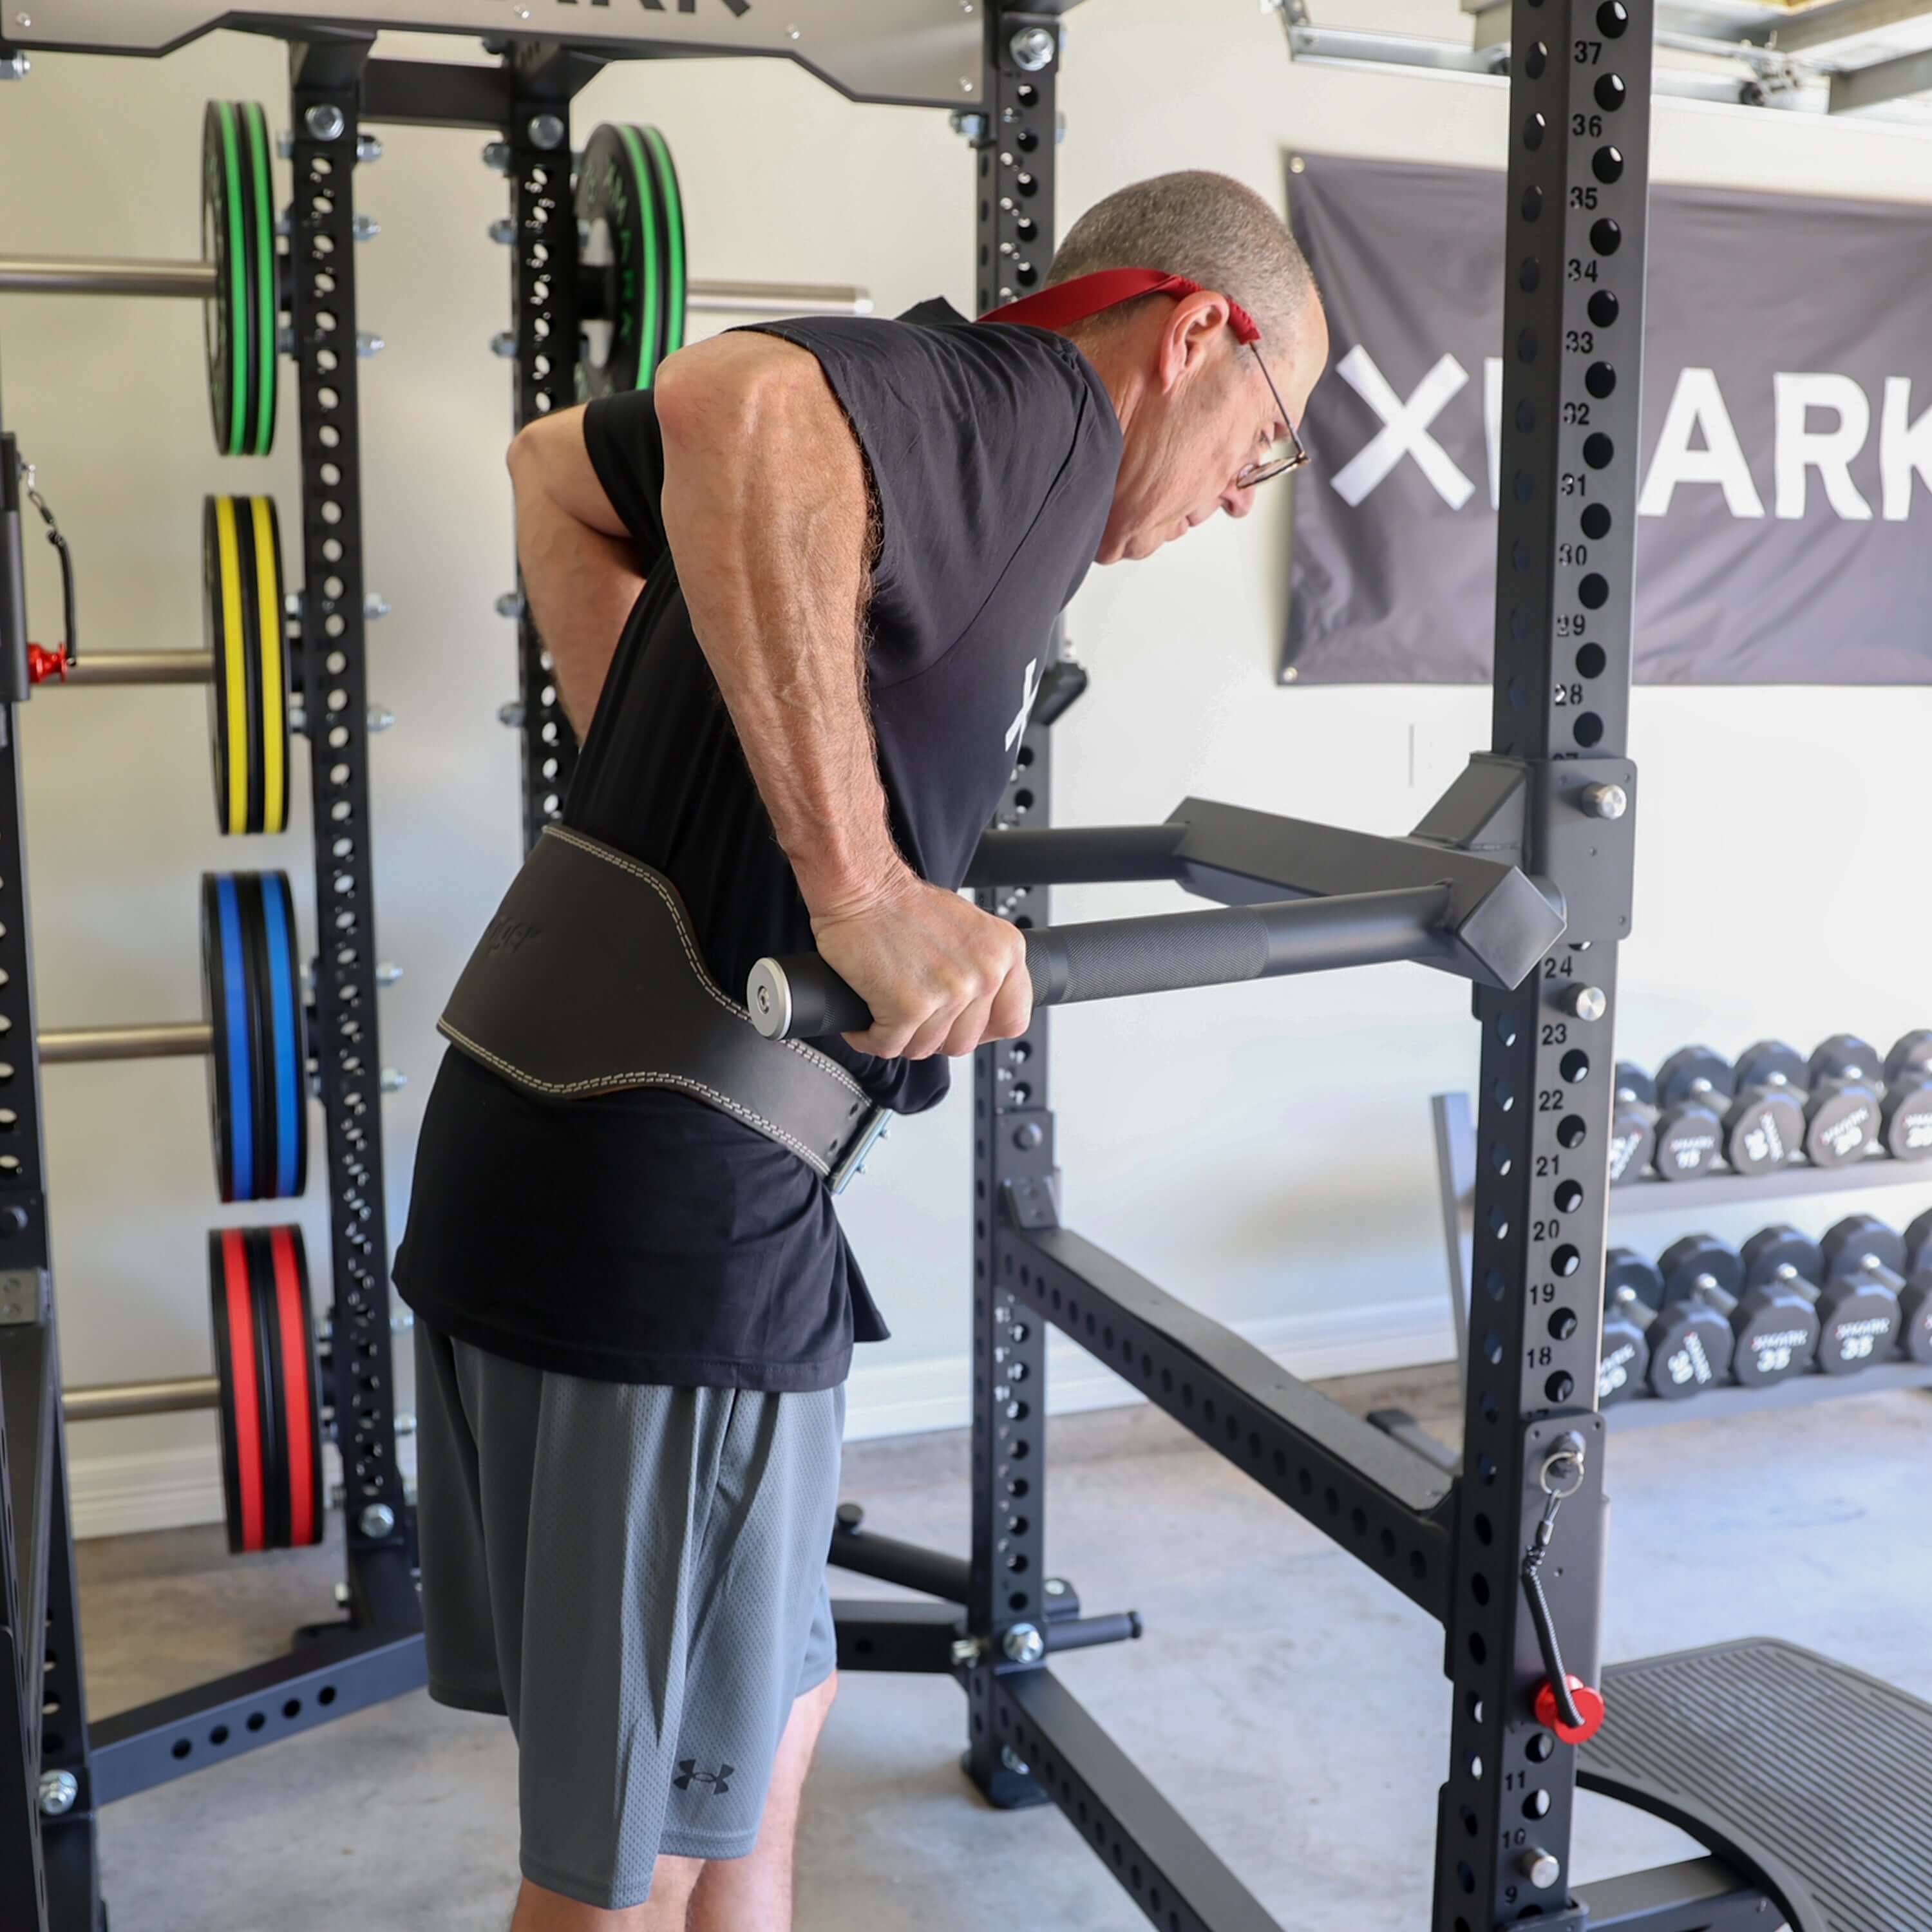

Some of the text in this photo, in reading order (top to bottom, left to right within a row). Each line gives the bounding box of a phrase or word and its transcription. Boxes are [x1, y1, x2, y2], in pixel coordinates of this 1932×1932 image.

[1574, 41, 1602, 65] 37
[1572, 113, 1603, 138] 36
[1570, 186, 1598, 210] 35
[1568, 259, 1598, 283] 34
[1566, 330, 1594, 354] 33
[1564, 402, 1590, 426] 32
[1331, 345, 1932, 520] XARK
[1561, 473, 1586, 497] 31
[1558, 543, 1587, 566] 30
[1557, 614, 1586, 637] 29
[1555, 683, 1583, 706] 28
[1544, 956, 1573, 979] 24
[1542, 1023, 1567, 1046] 23
[1539, 1089, 1564, 1112] 22
[1536, 1155, 1560, 1177] 21
[1533, 1219, 1560, 1242] 20
[1530, 1283, 1555, 1305] 19
[1527, 1347, 1552, 1368] 18
[1505, 1770, 1526, 1791] 11
[1502, 1828, 1526, 1849] 10
[1505, 1885, 1518, 1903] 9
